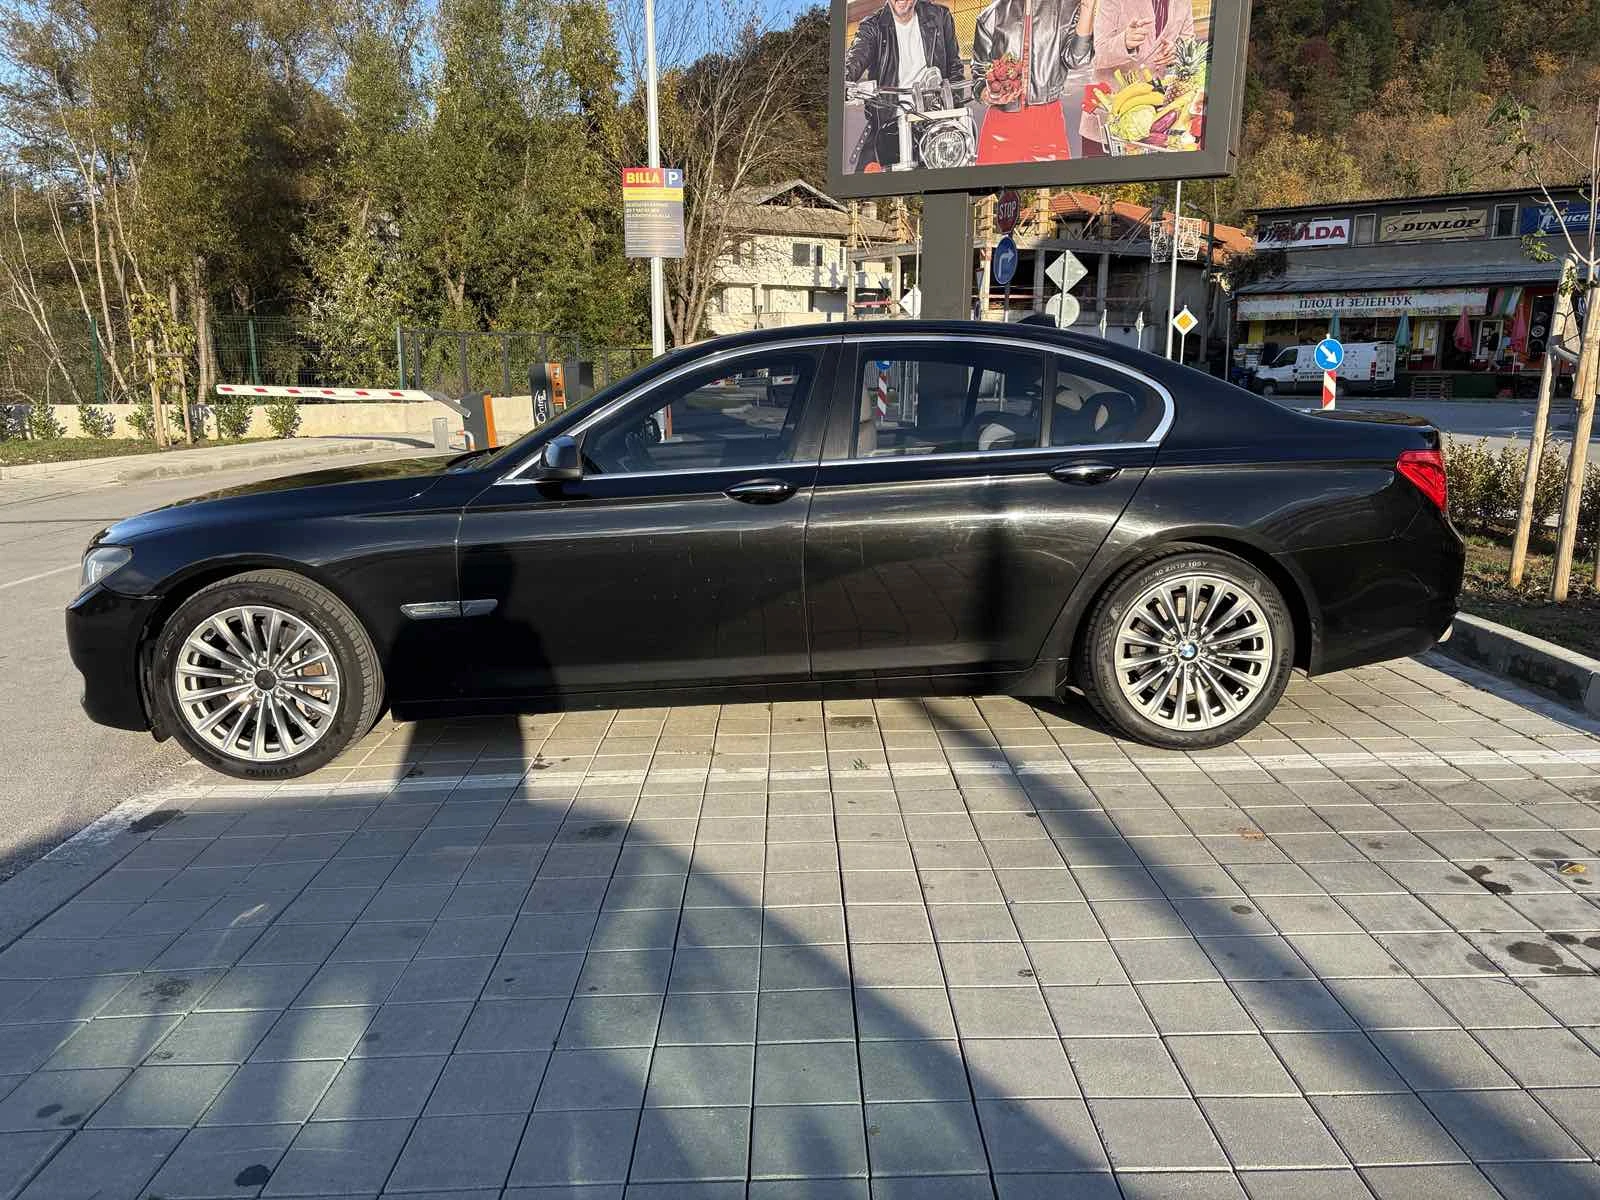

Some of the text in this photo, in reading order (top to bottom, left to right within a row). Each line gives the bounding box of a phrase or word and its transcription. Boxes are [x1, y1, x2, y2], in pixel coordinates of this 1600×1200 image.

[626, 172, 660, 184] BILLA
[668, 171, 678, 185] P
[999, 200, 1016, 220] STOP
[1401, 218, 1480, 232] DUNLOP
[1299, 295, 1413, 309] ПЛОД И ЗЕЛЕНЧУК
